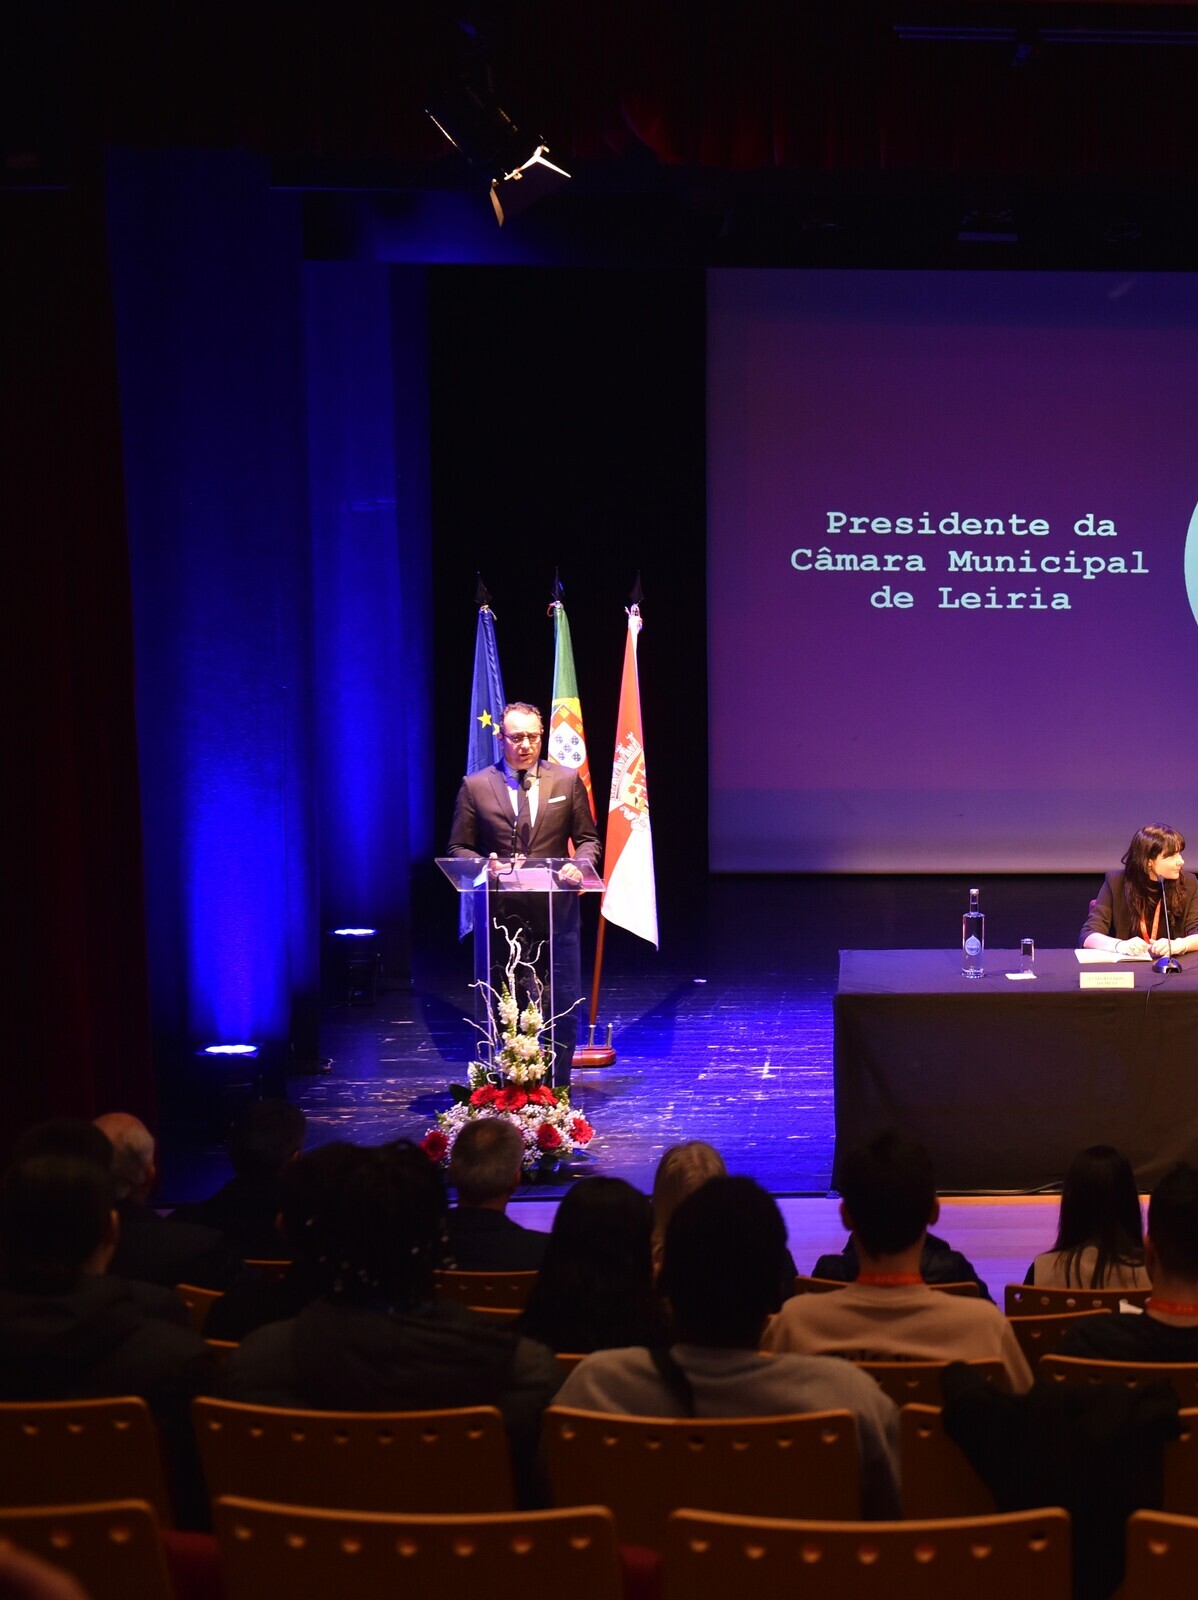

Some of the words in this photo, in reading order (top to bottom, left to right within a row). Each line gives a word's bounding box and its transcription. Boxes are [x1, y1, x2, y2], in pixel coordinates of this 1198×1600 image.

[826, 511, 1050, 536] Presidente
[1073, 513, 1118, 537] da
[790, 546, 927, 572] Câmara
[947, 549, 1149, 580] Municipal
[870, 585, 914, 609] de
[938, 586, 1072, 610] Leiria
